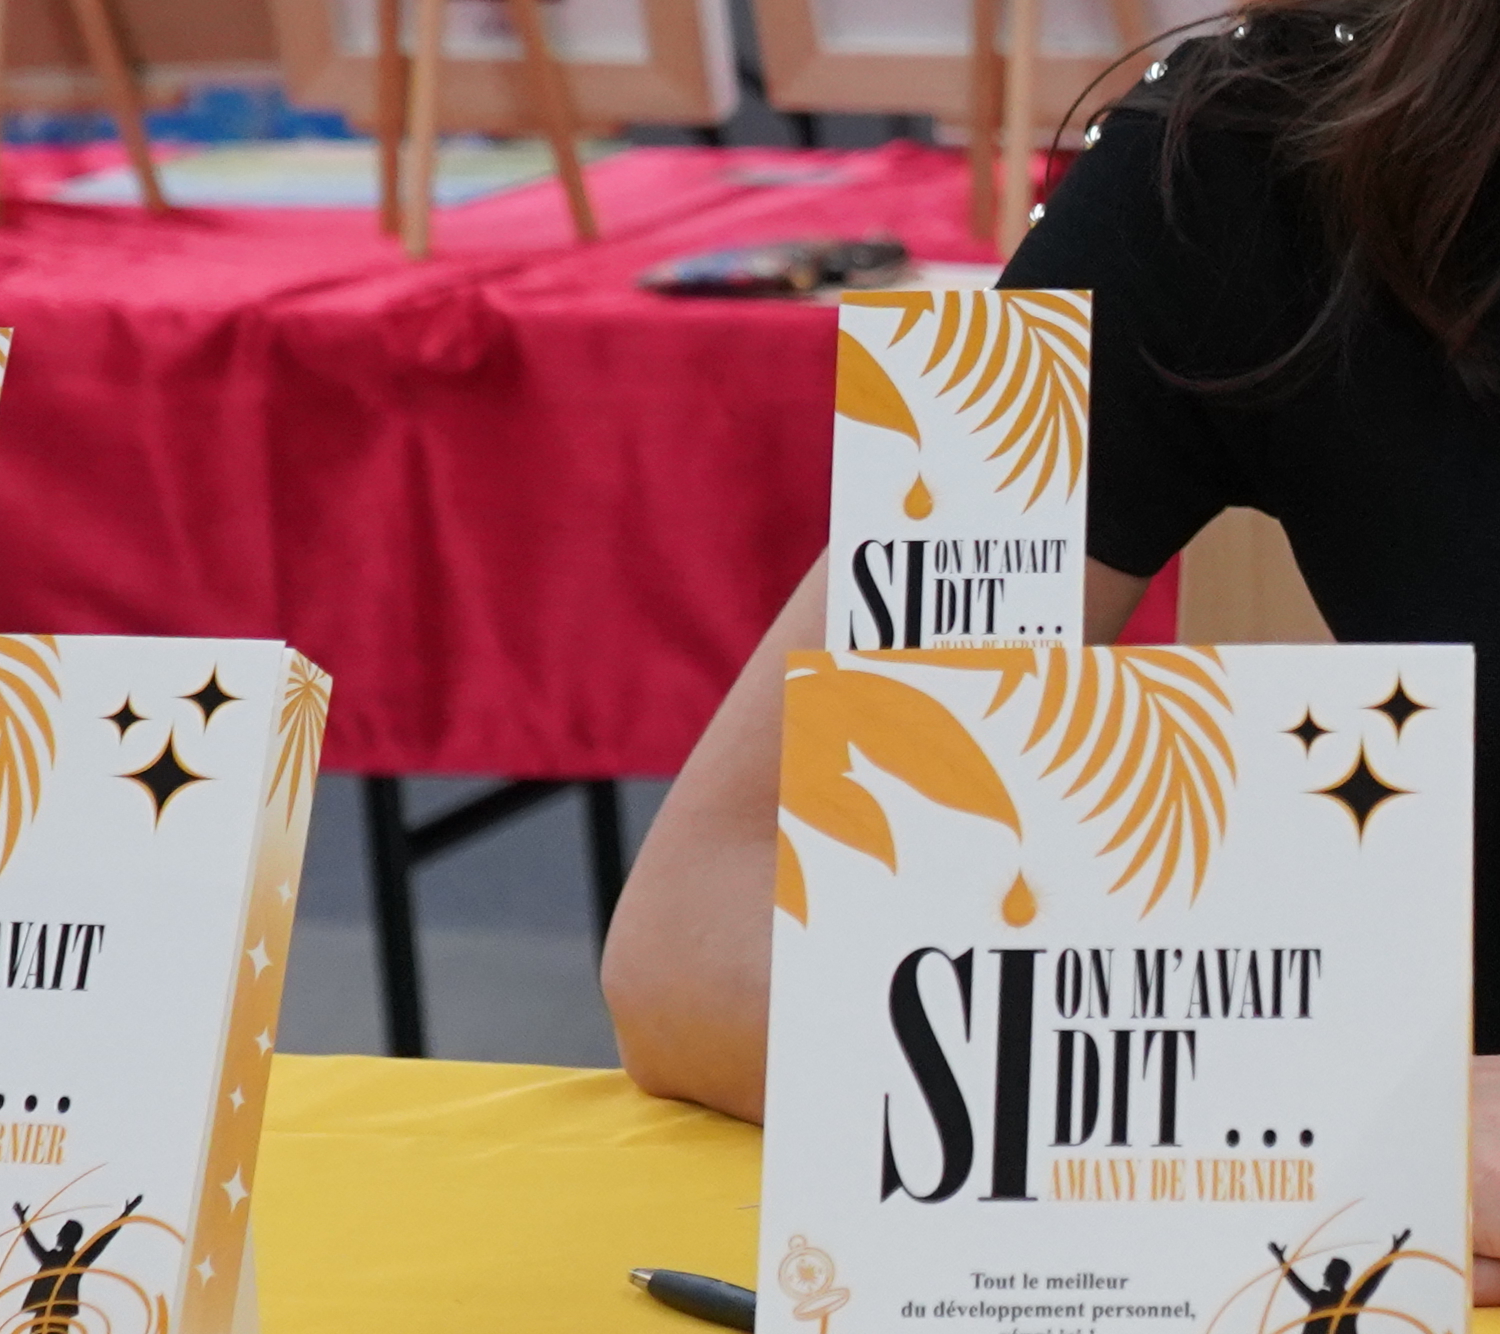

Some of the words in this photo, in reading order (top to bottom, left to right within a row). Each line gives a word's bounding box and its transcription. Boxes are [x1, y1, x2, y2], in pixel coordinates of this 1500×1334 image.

[933, 540, 965, 574] ON
[932, 578, 1005, 635] DIT
[880, 946, 1048, 1204] SI
[1054, 948, 1114, 1020] ON
[1047, 1029, 1197, 1148] DIT
[1047, 1159, 1139, 1202] AMANY
[1149, 1160, 1186, 1202] DE
[1195, 1160, 1317, 1202] VERNIER
[971, 1272, 1015, 1290] Tout
[1023, 1272, 1039, 1290] le
[1046, 1272, 1129, 1291] meilleur
[901, 1300, 926, 1318] du
[933, 1300, 1085, 1322] développement
[1091, 1301, 1196, 1322] personnel,
